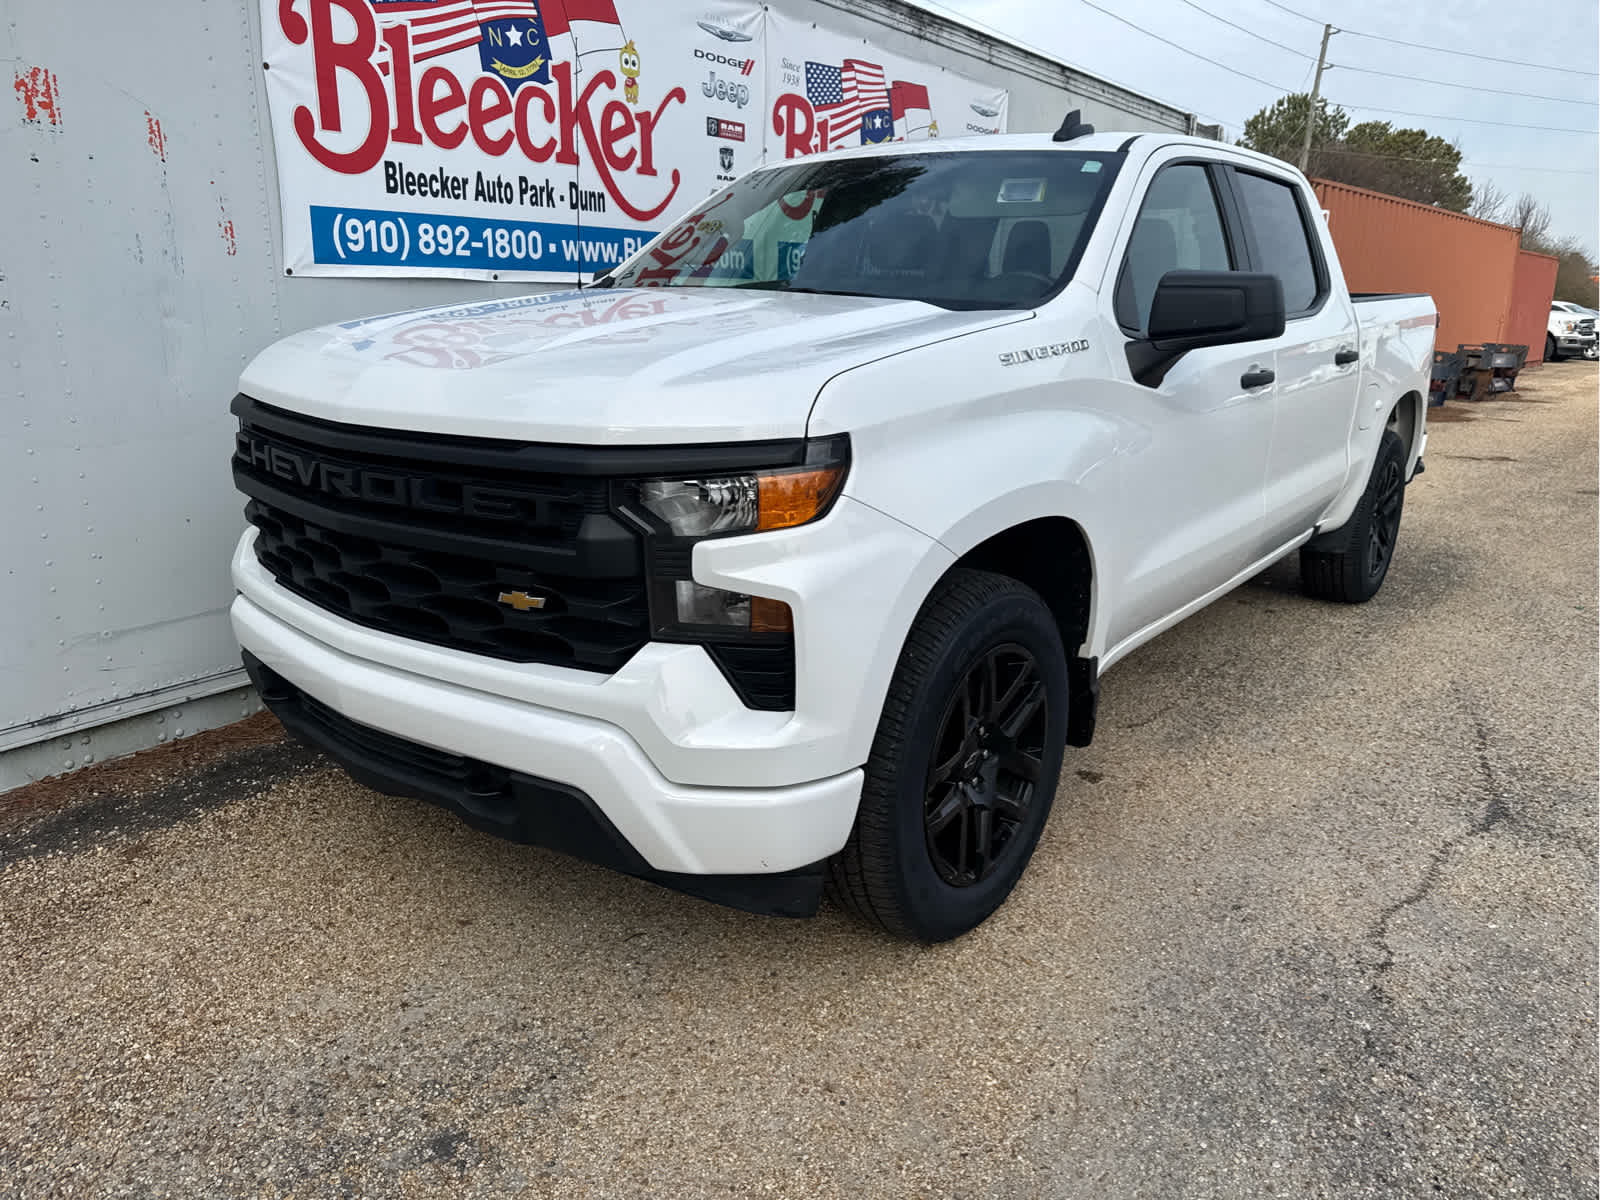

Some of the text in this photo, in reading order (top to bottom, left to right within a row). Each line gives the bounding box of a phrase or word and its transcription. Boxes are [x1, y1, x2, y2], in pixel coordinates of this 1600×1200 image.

[488, 26, 503, 47] N
[694, 49, 748, 69] DODGE
[781, 57, 801, 73] Since
[702, 71, 750, 109] Jeep
[782, 72, 801, 87] 1938
[278, 0, 686, 222] Bleecker
[720, 123, 743, 133] RAM
[384, 160, 606, 213] Bleecker Auto Park Dunn
[332, 213, 410, 261] (910)
[418, 222, 542, 260] 892-1800
[999, 339, 1090, 367] SILVERADO
[235, 431, 584, 523] CHEVROLET
